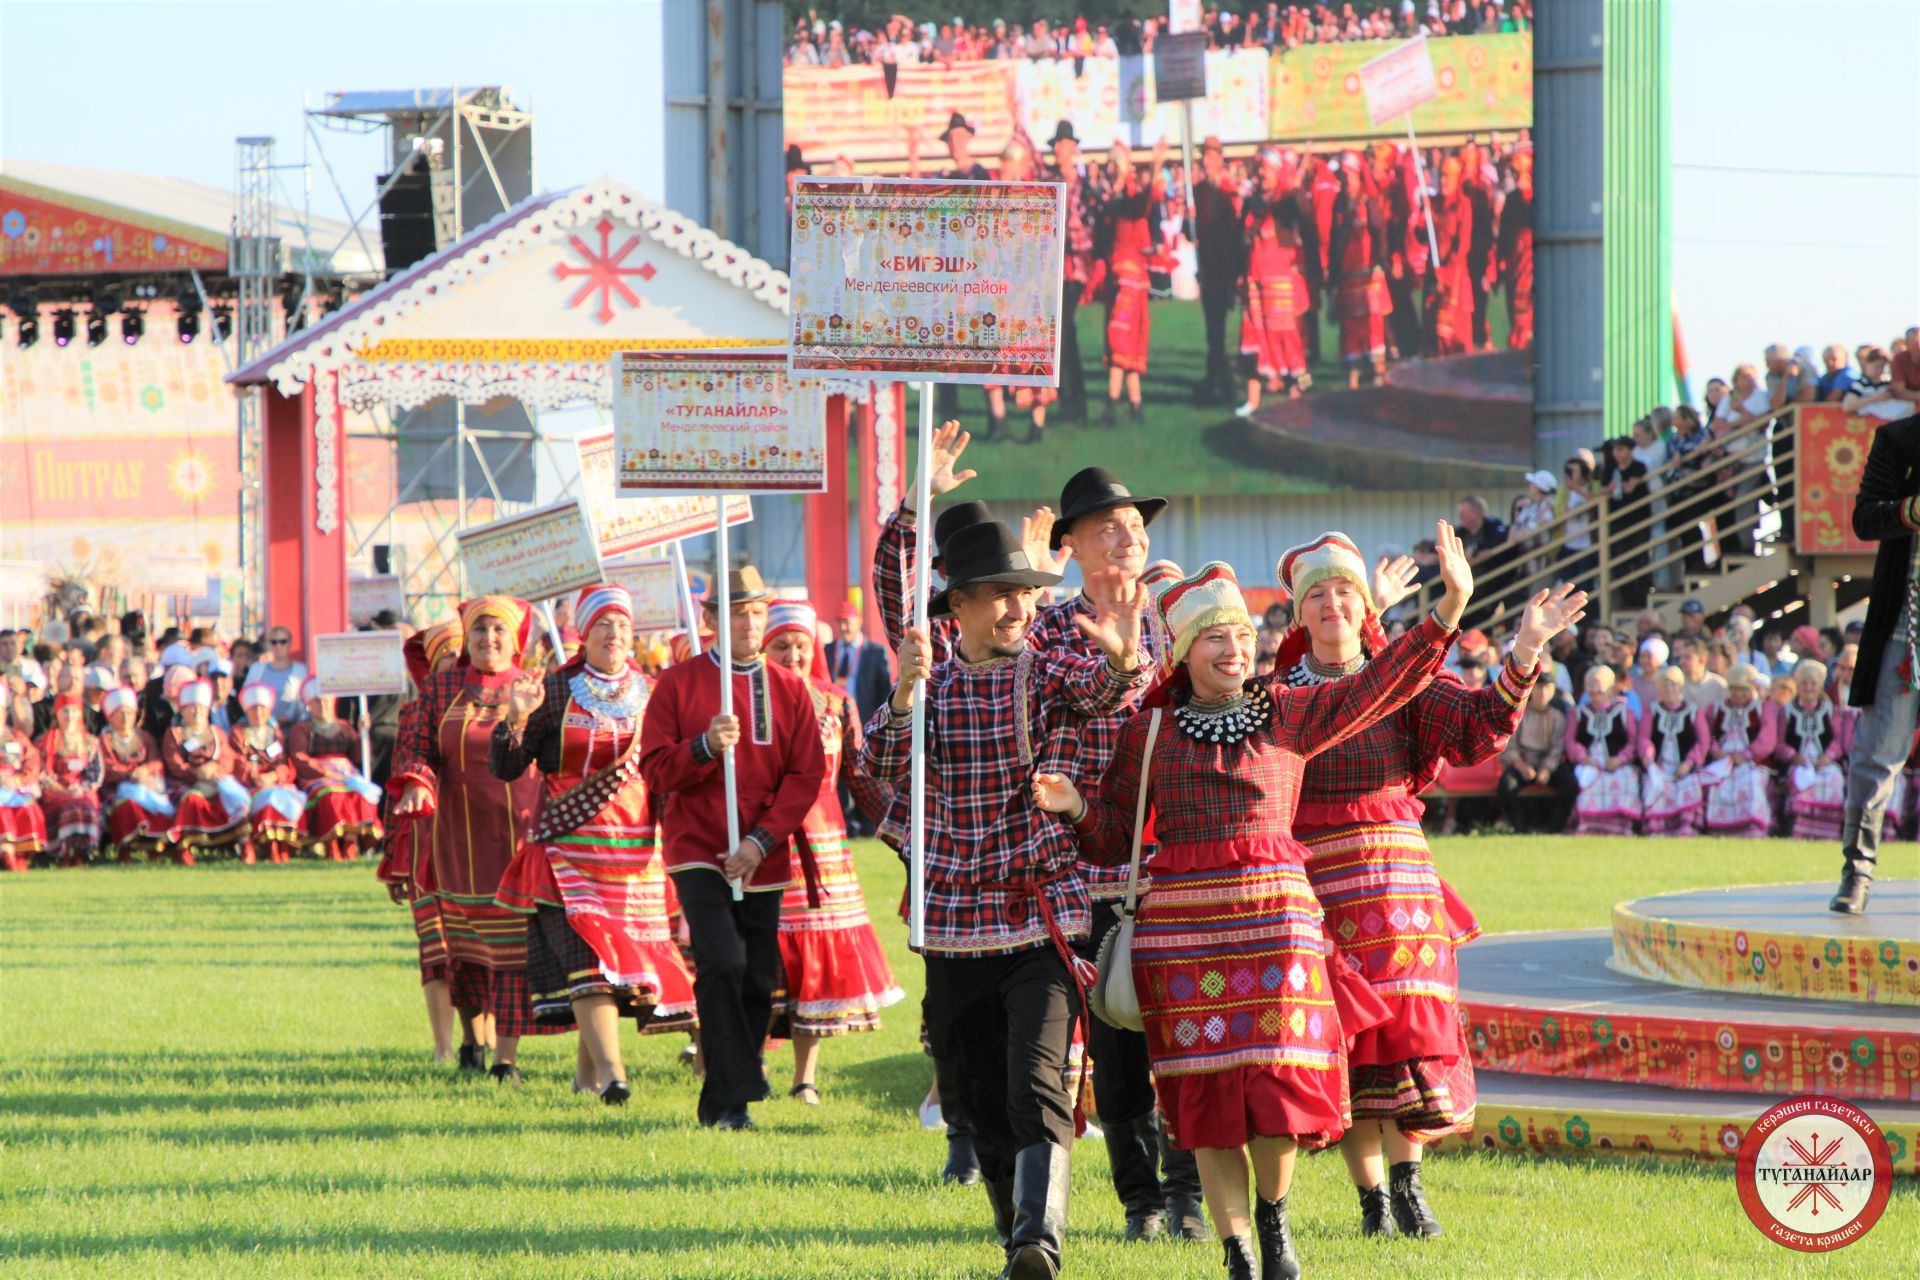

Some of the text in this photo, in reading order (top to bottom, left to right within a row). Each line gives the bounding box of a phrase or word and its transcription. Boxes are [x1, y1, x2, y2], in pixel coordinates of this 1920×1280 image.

[880, 255, 978, 273] «БИГЭШ»
[844, 277, 1008, 296] Менделеевский район
[665, 402, 789, 417] «ТУГАНАЙЛАР»
[661, 421, 789, 433] Менделеевский район
